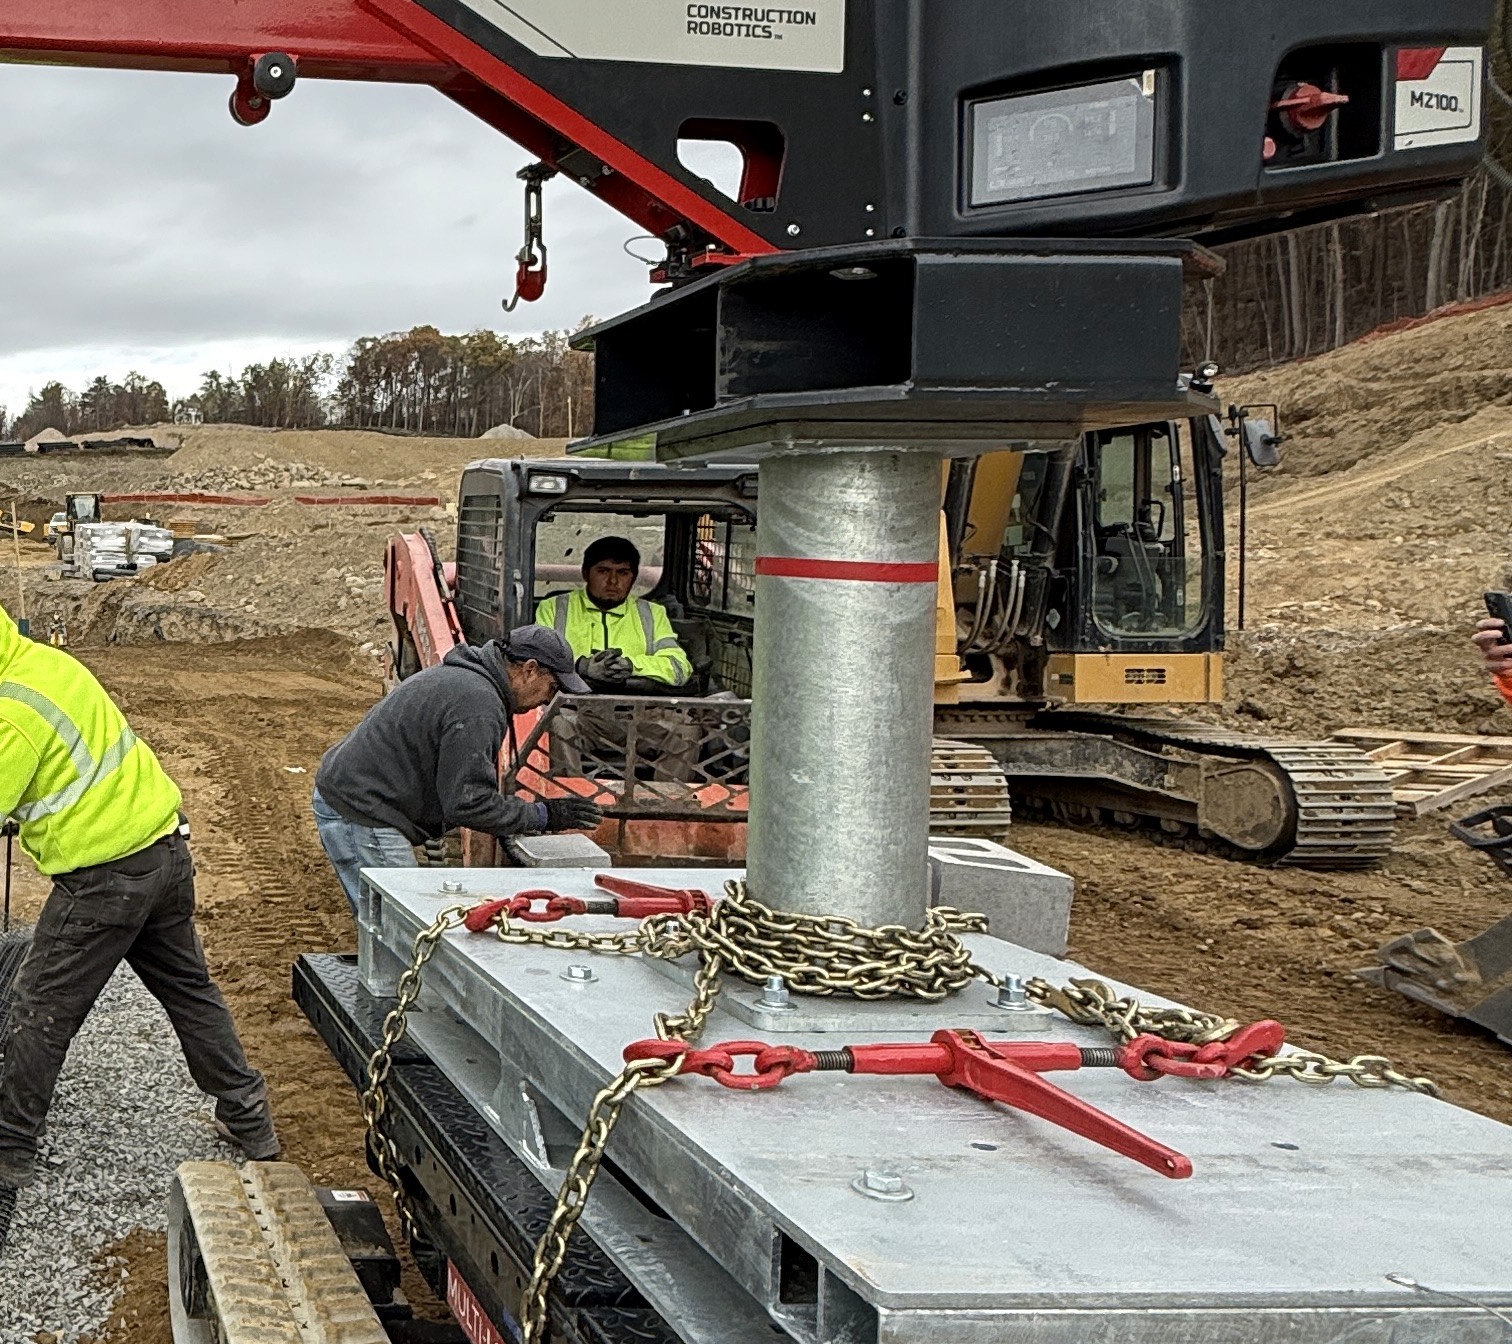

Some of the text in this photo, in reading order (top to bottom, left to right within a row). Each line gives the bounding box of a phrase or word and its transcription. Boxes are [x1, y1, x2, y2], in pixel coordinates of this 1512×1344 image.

[687, 4, 817, 25] CONSTRUCTION
[687, 21, 773, 39] ROBOTICS
[1410, 90, 1459, 113] MZ100
